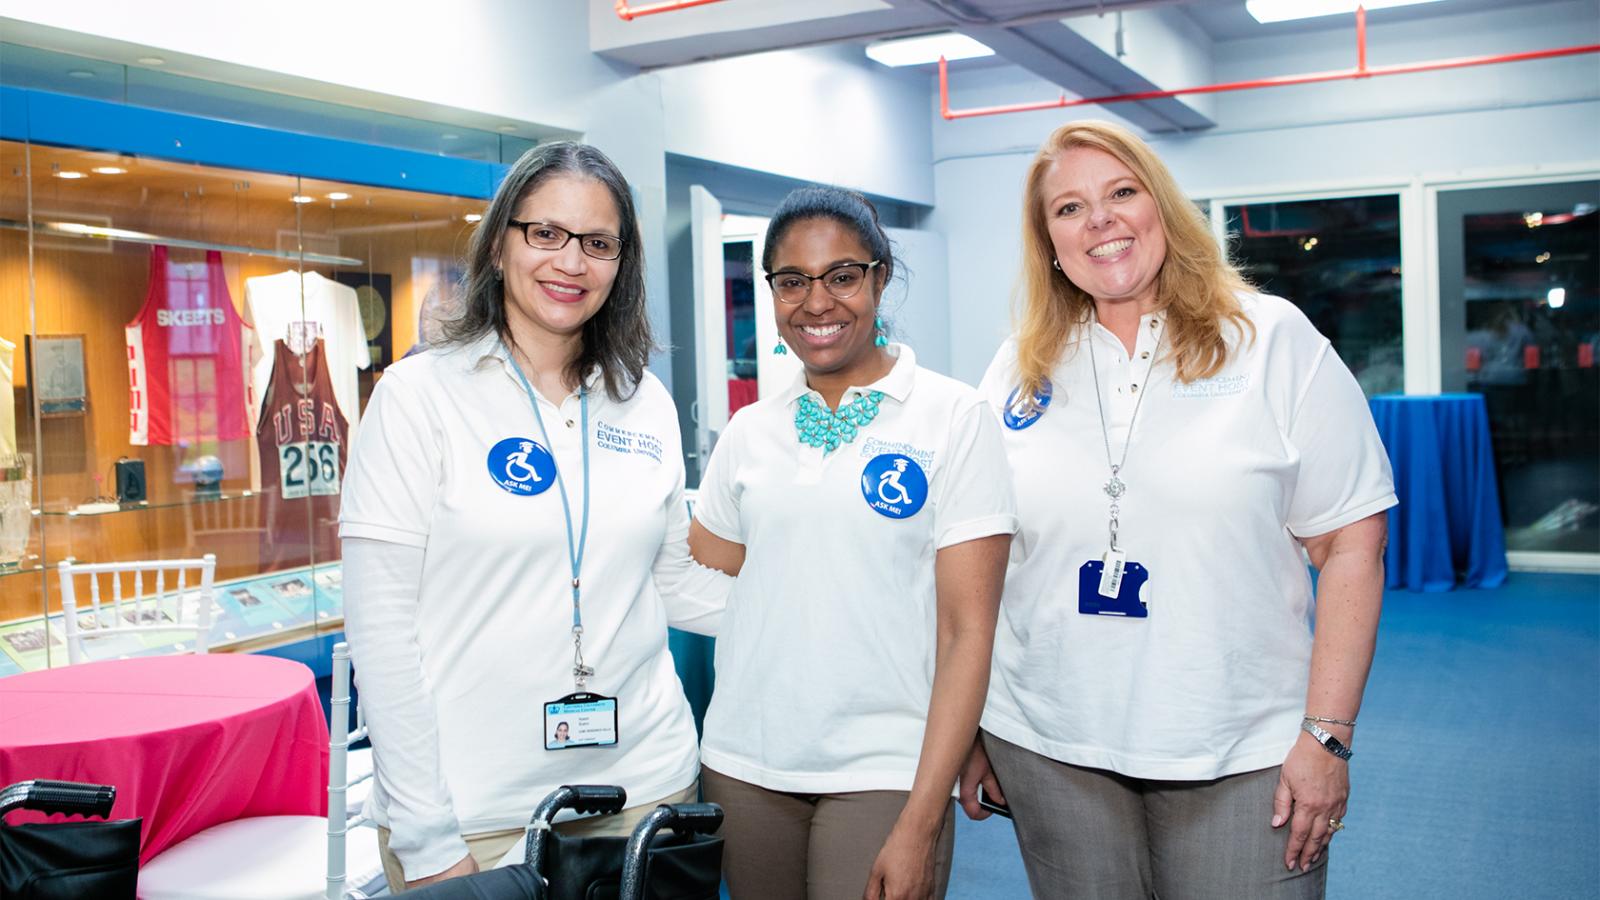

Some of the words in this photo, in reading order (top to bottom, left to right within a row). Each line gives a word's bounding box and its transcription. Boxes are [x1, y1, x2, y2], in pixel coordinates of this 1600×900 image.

[156, 308, 226, 327] SKEETS
[273, 398, 341, 447] USA
[597, 429, 633, 448] EVENT
[637, 439, 663, 458] HOST
[597, 440, 632, 453] COLUMBIA
[283, 444, 336, 488] 256
[503, 479, 519, 488] ASK
[519, 482, 532, 492] ME!
[874, 500, 889, 510] ASK
[889, 505, 902, 515] ME!
